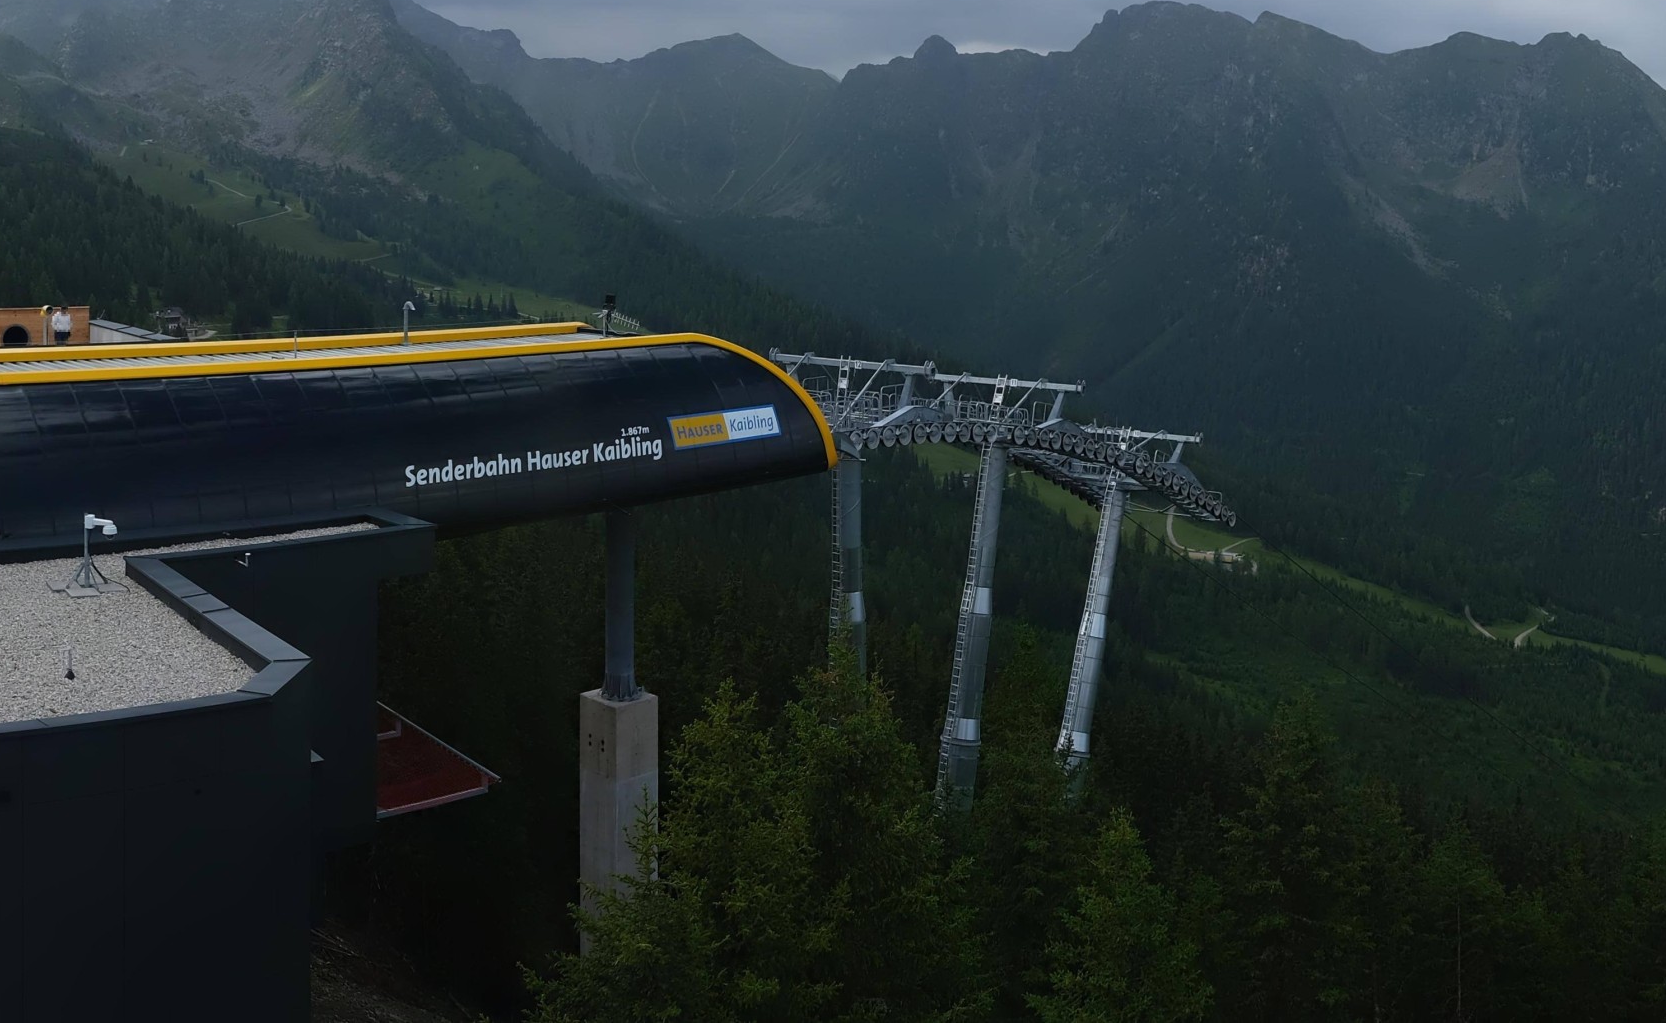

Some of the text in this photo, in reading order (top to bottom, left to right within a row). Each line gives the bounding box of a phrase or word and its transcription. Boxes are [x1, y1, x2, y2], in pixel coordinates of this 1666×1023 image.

[620, 425, 650, 437] 1.867m
[675, 414, 774, 439] HAUSER Kaibling
[405, 436, 663, 488] Senderbahn Hauser Kaibling
